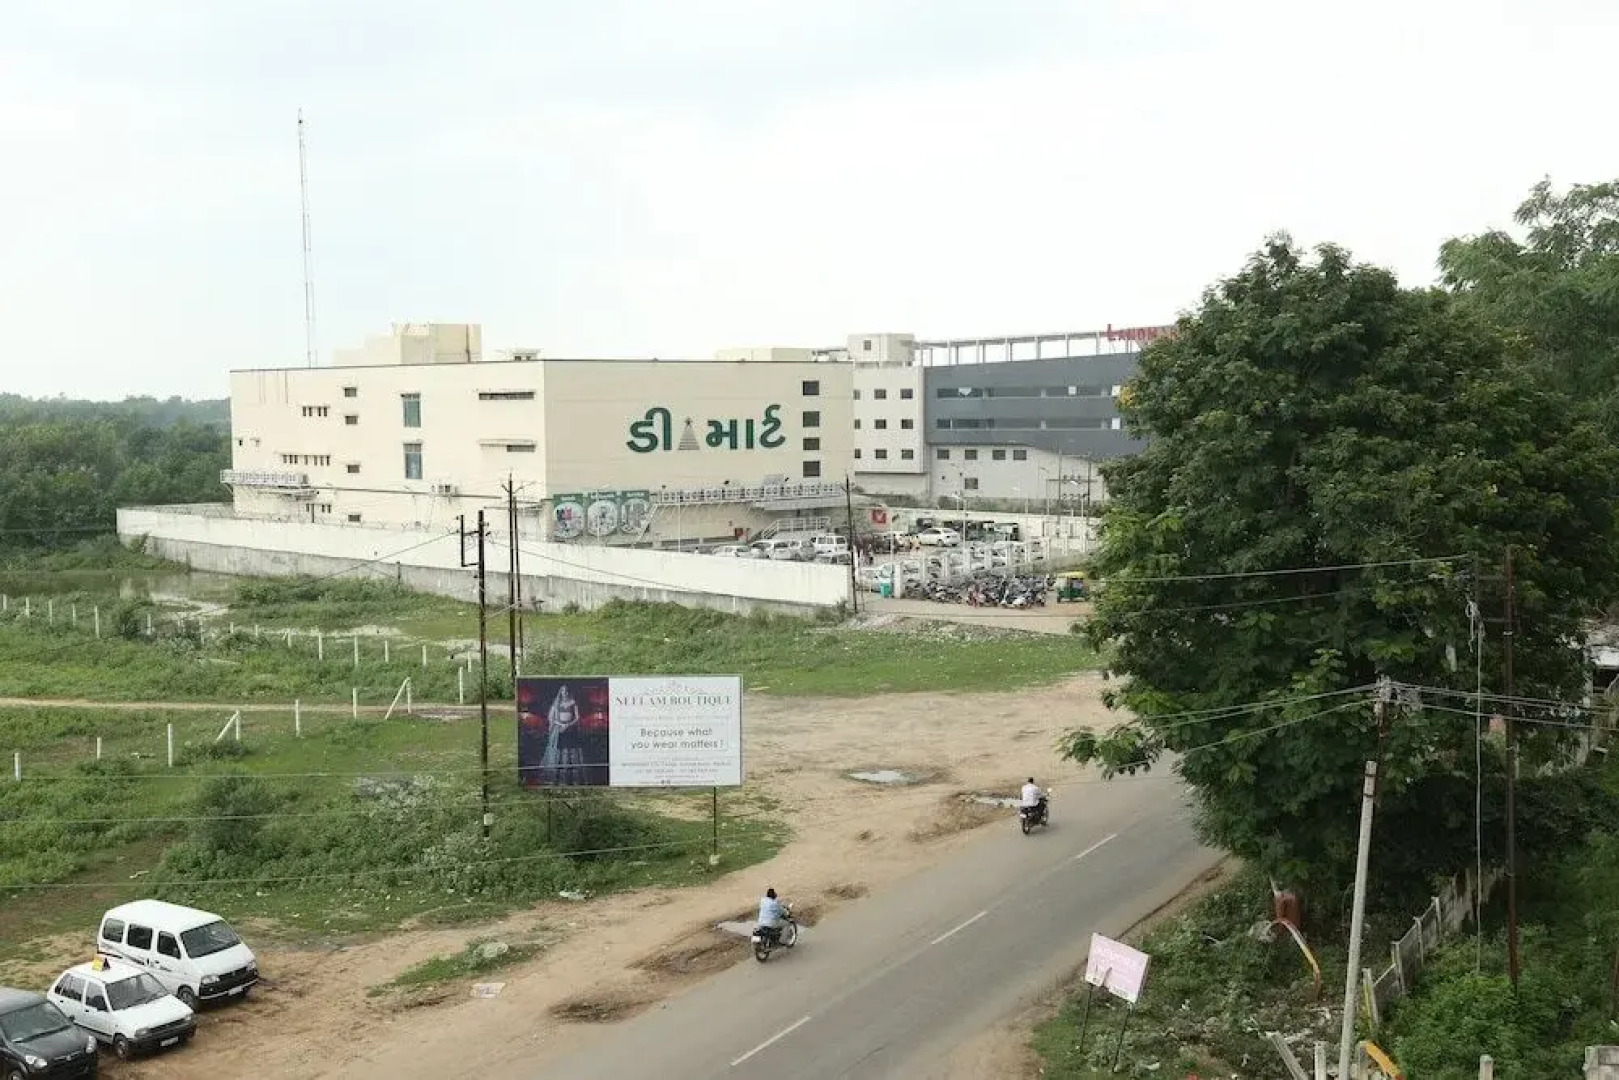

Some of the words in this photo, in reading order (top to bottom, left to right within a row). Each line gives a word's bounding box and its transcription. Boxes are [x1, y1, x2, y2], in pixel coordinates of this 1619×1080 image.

[626, 407, 672, 453] ડી
[705, 404, 786, 451] માર્ટ
[670, 696, 732, 706] BOUTIQUE
[640, 728, 684, 737] Because
[688, 728, 712, 736] what
[631, 741, 650, 749] you
